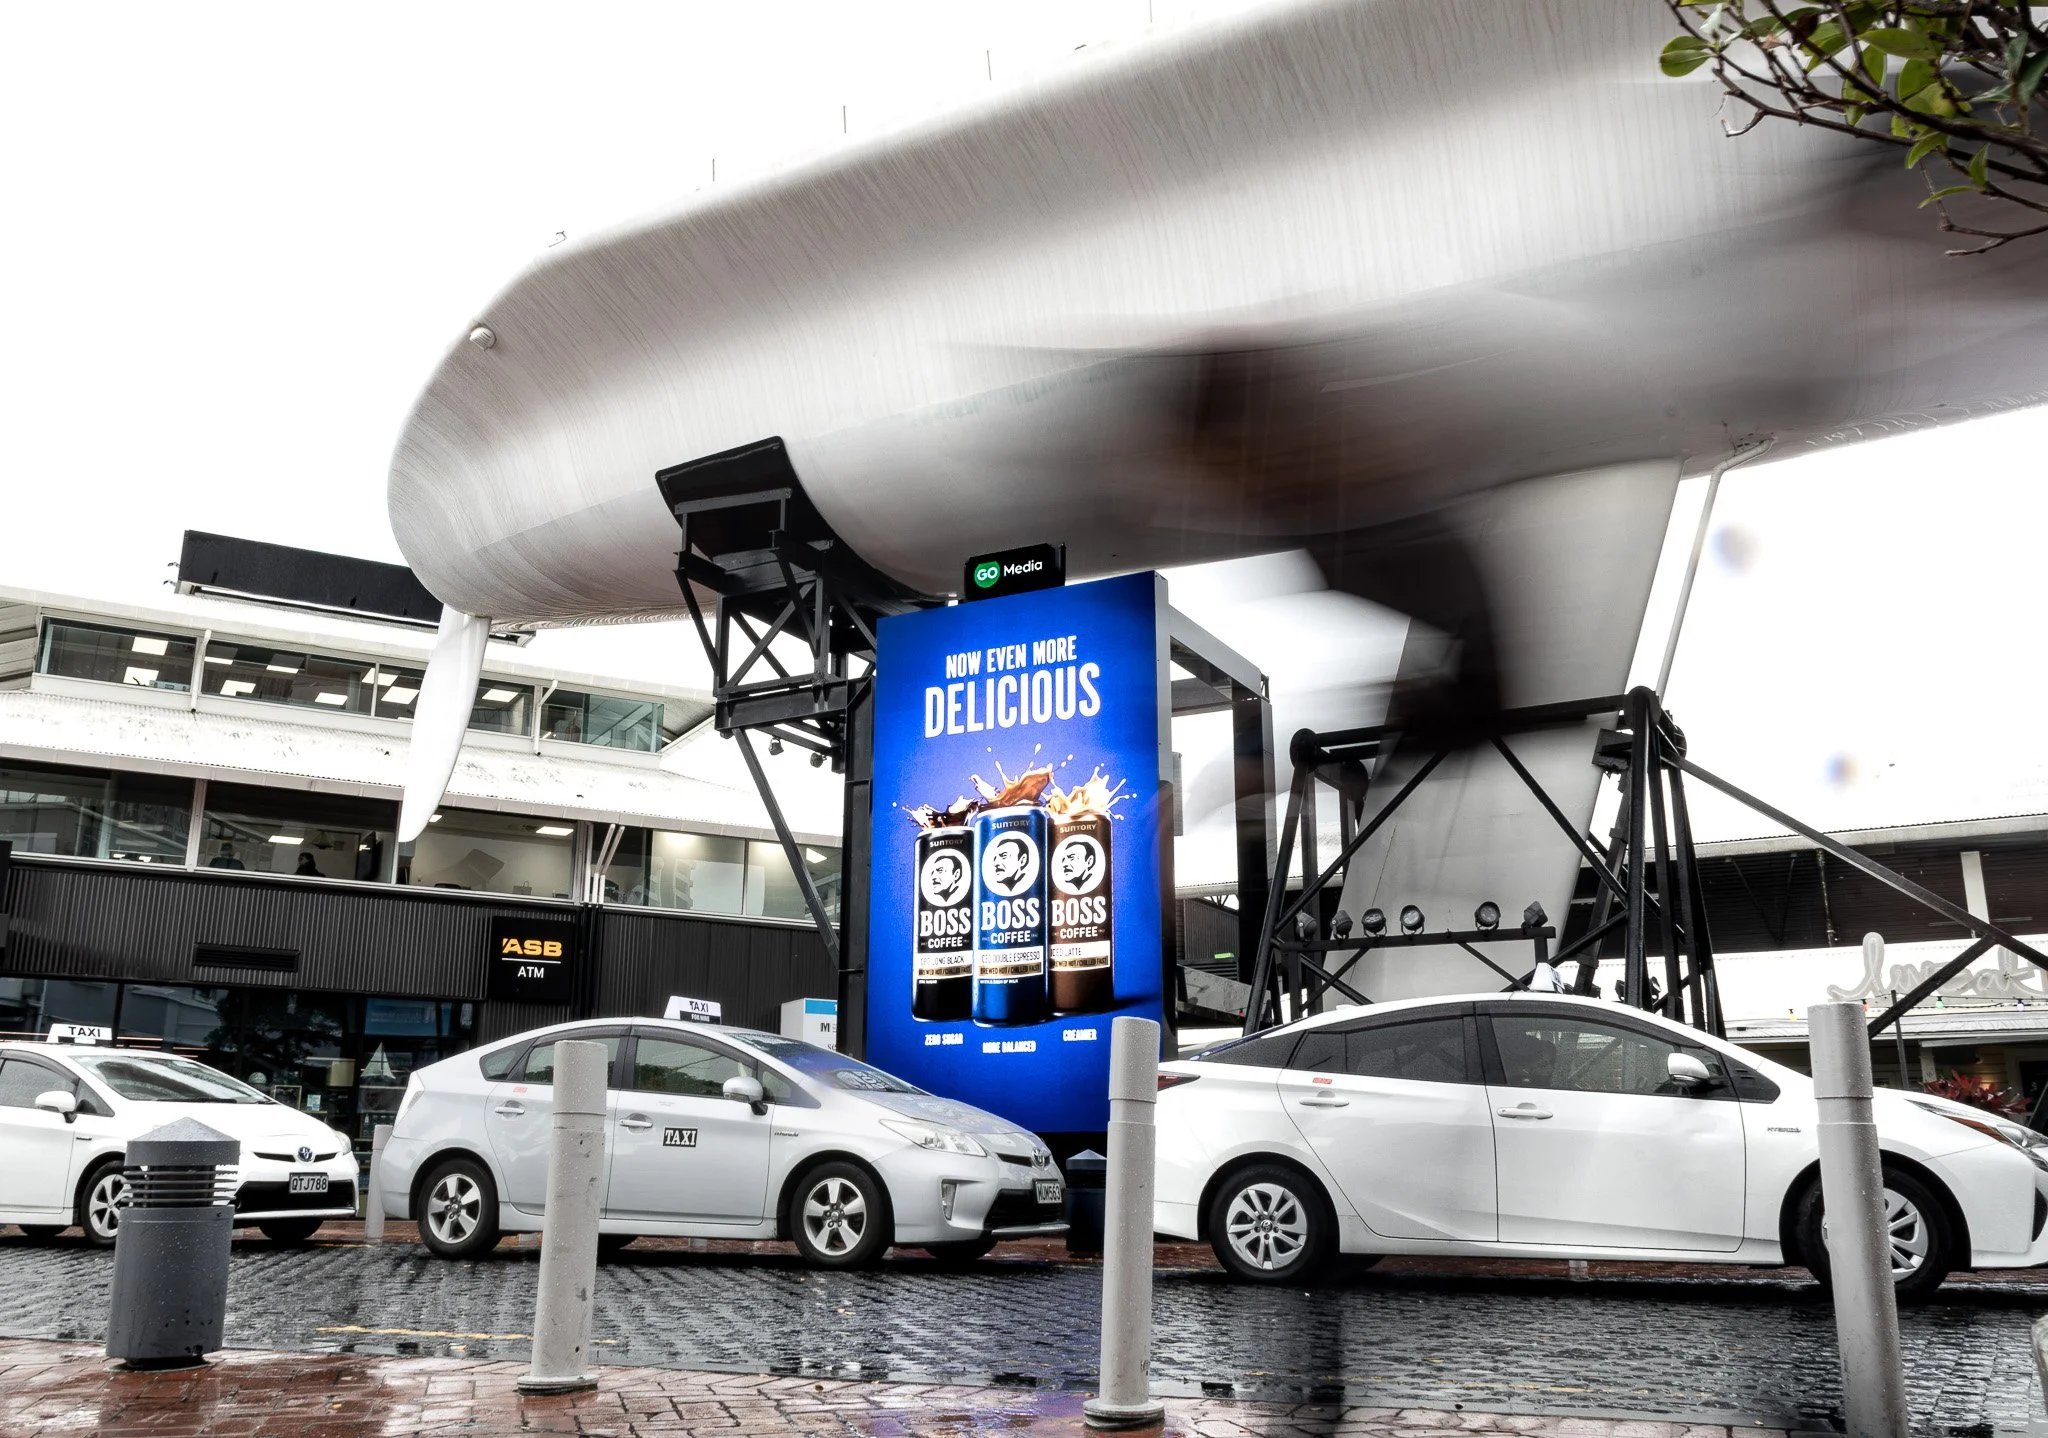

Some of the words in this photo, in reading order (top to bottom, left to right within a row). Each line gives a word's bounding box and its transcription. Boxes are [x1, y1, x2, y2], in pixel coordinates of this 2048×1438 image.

[977, 566, 998, 581] GO
[1003, 560, 1043, 576] Media
[946, 650, 981, 679] NOW
[987, 643, 1026, 673] EVEN
[1033, 635, 1077, 666] MORE
[924, 662, 1101, 739] DELICIOUS
[991, 819, 1031, 831] SUNTORY
[1059, 823, 1097, 833] SUNTORY
[929, 838, 964, 848] SUNTORY
[981, 897, 1040, 931] BOSS
[1051, 896, 1107, 927] BOSS
[920, 907, 971, 937] BOSS
[990, 929, 1031, 944] COFFEE
[1059, 926, 1098, 939] COFFEE
[502, 937, 563, 957] ASB
[928, 936, 963, 949] COFFEE
[1013, 951, 1040, 962] ESPRESSO
[1065, 947, 1082, 956] LATTE
[947, 955, 965, 965] BLACK
[517, 966, 545, 978] ATM
[689, 1000, 709, 1013] TAXI
[68, 1026, 101, 1037] TAXI
[924, 1034, 941, 1046] ZERO
[942, 1033, 964, 1045] SUGAR
[1001, 1040, 1037, 1053] BALANCED
[665, 1130, 697, 1146] TAXI
[291, 1177, 327, 1190] QTJ788
